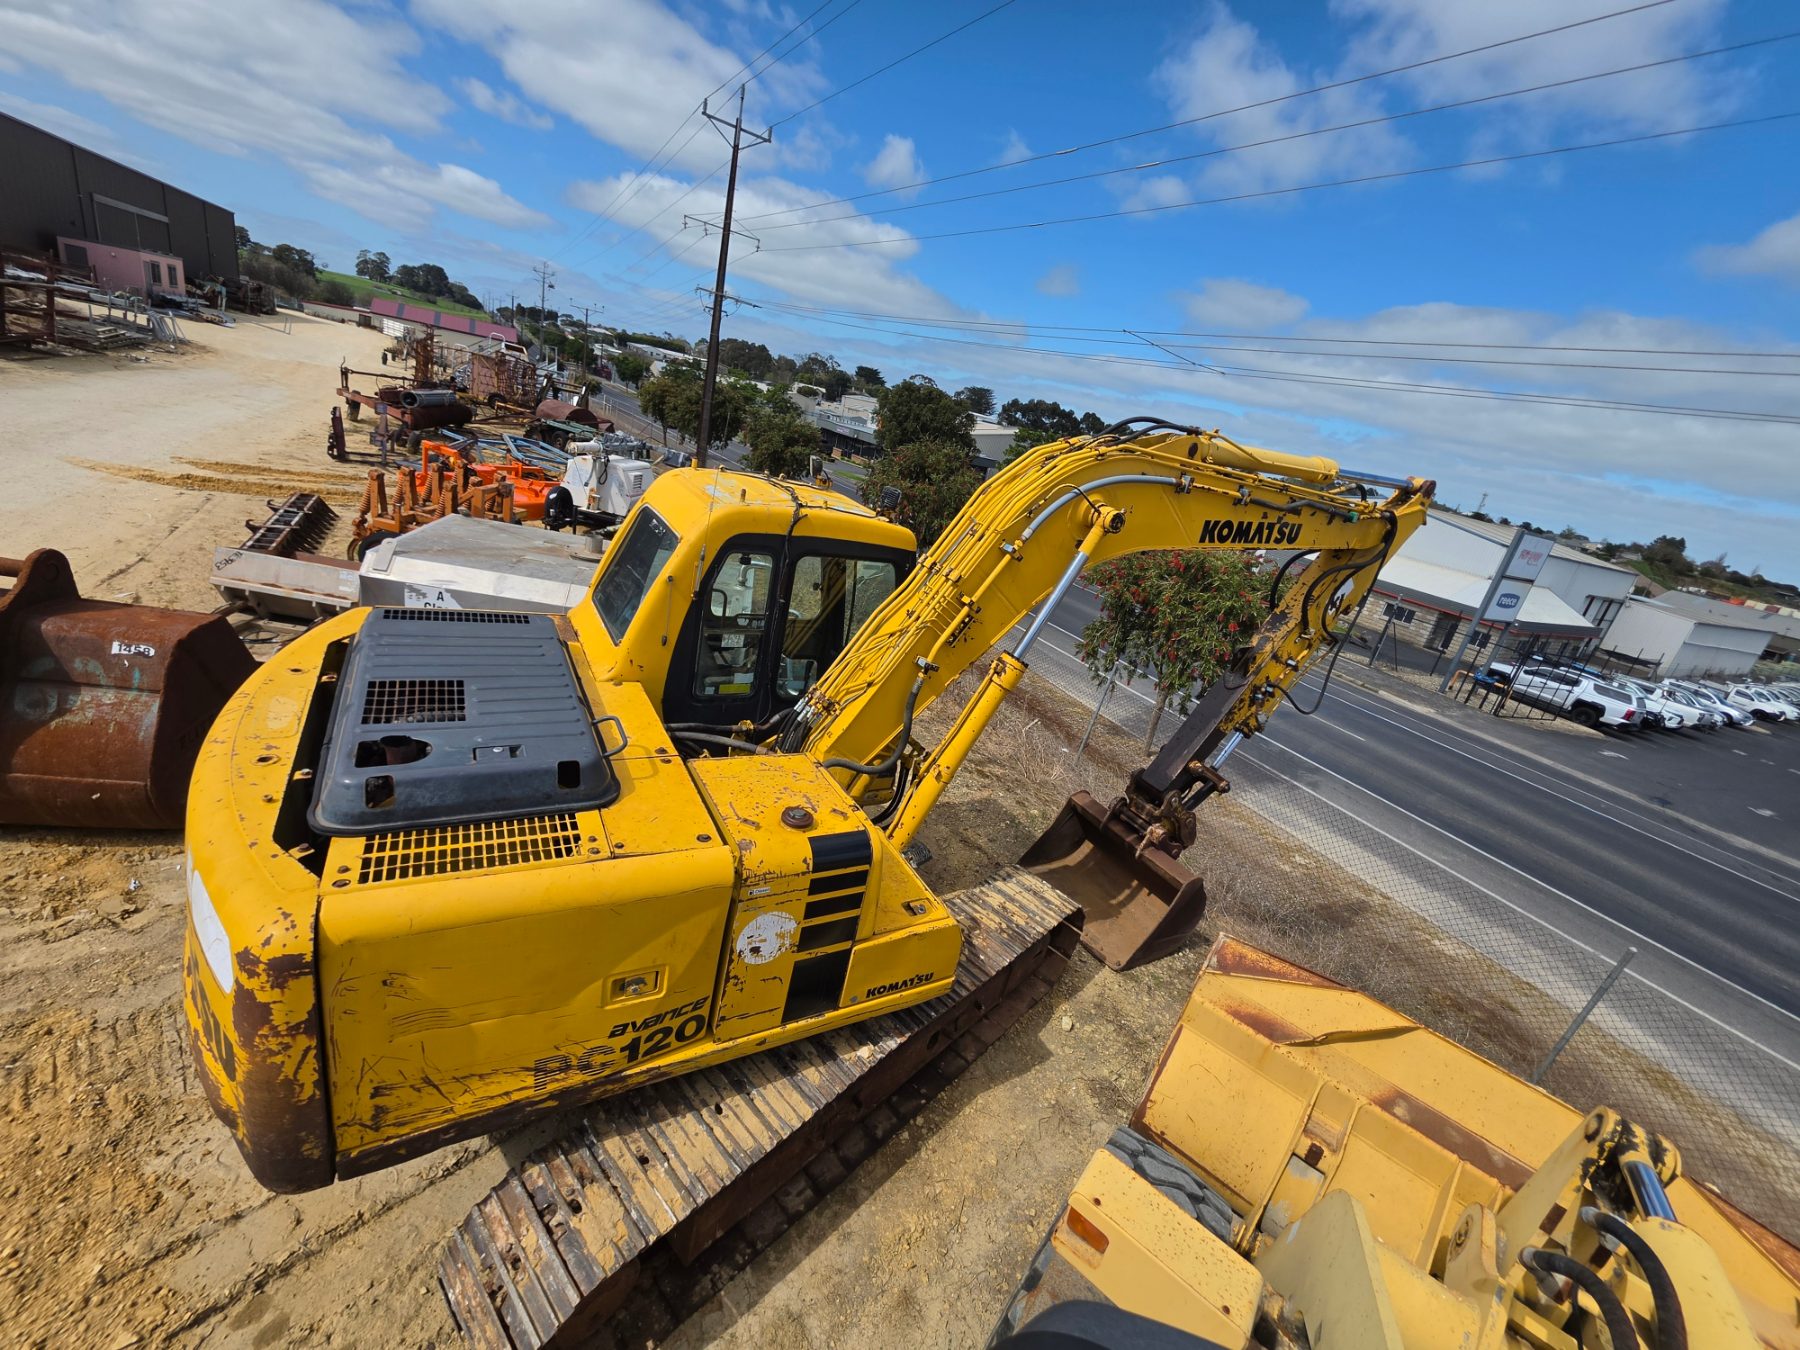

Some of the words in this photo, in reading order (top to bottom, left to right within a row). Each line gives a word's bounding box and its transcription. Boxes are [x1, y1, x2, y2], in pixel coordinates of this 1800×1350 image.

[1199, 518, 1303, 545] KOMATSU
[436, 591, 445, 602] A
[866, 972, 934, 998] KOMATSU
[608, 996, 710, 1039] avance
